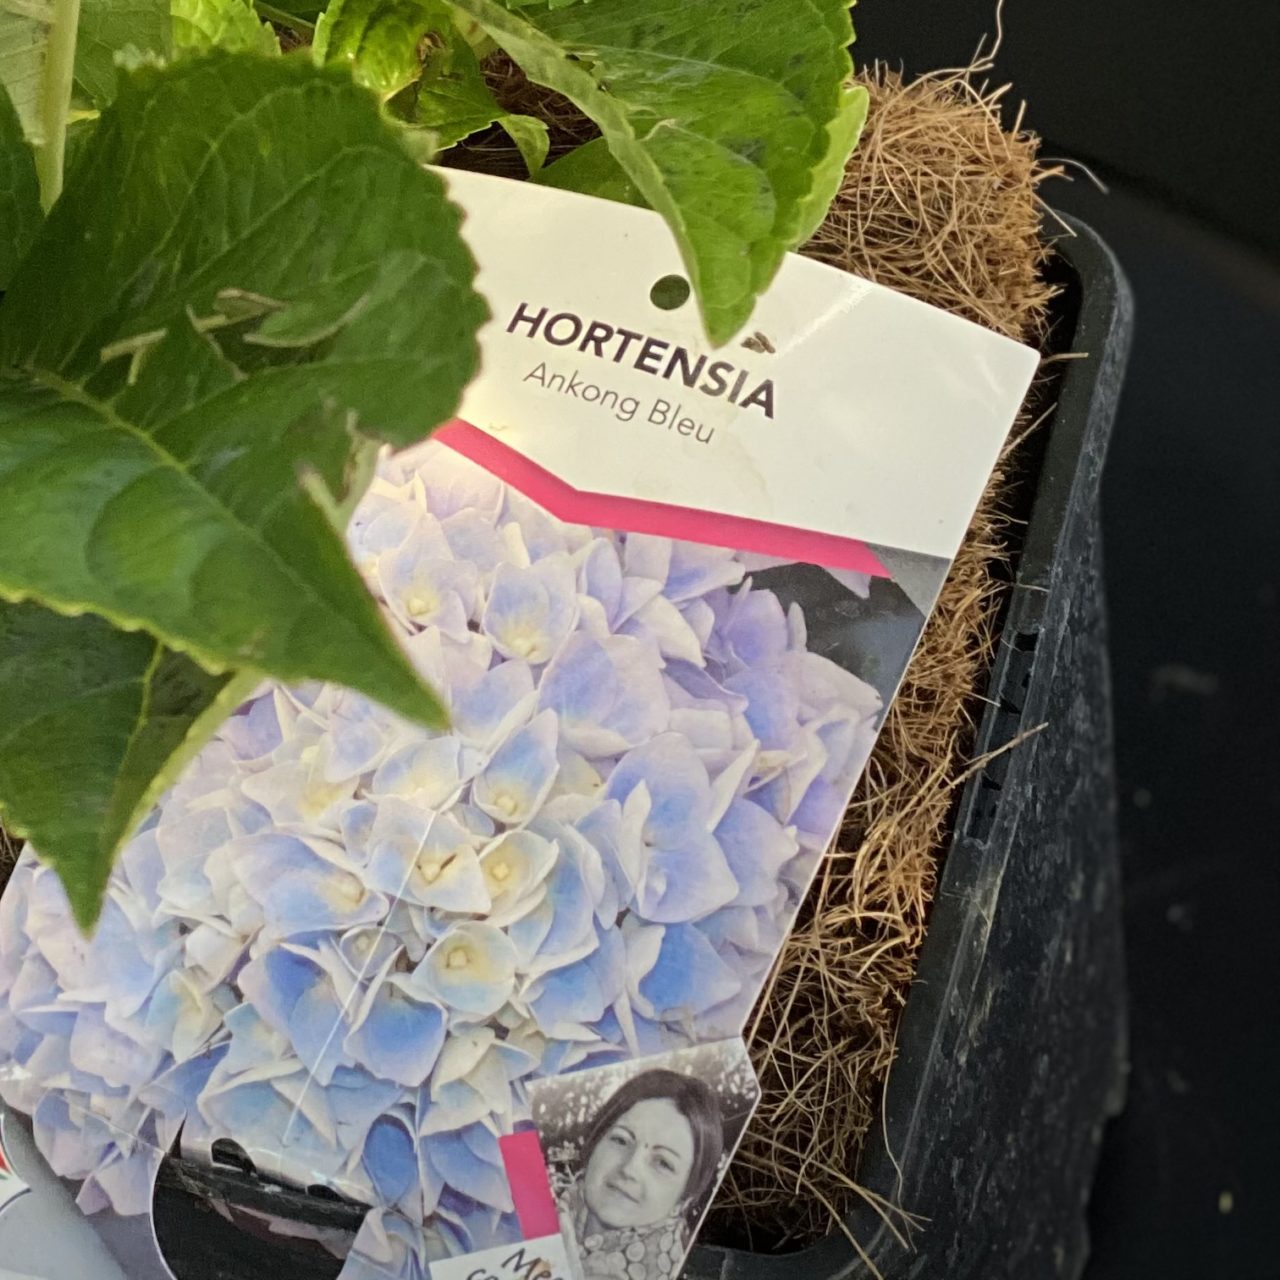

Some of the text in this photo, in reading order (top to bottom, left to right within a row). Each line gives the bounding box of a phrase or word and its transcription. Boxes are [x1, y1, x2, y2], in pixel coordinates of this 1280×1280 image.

[506, 302, 775, 420] HORTENSIA
[523, 361, 715, 445] Ankong Bleu
[501, 1247, 564, 1280] Me
